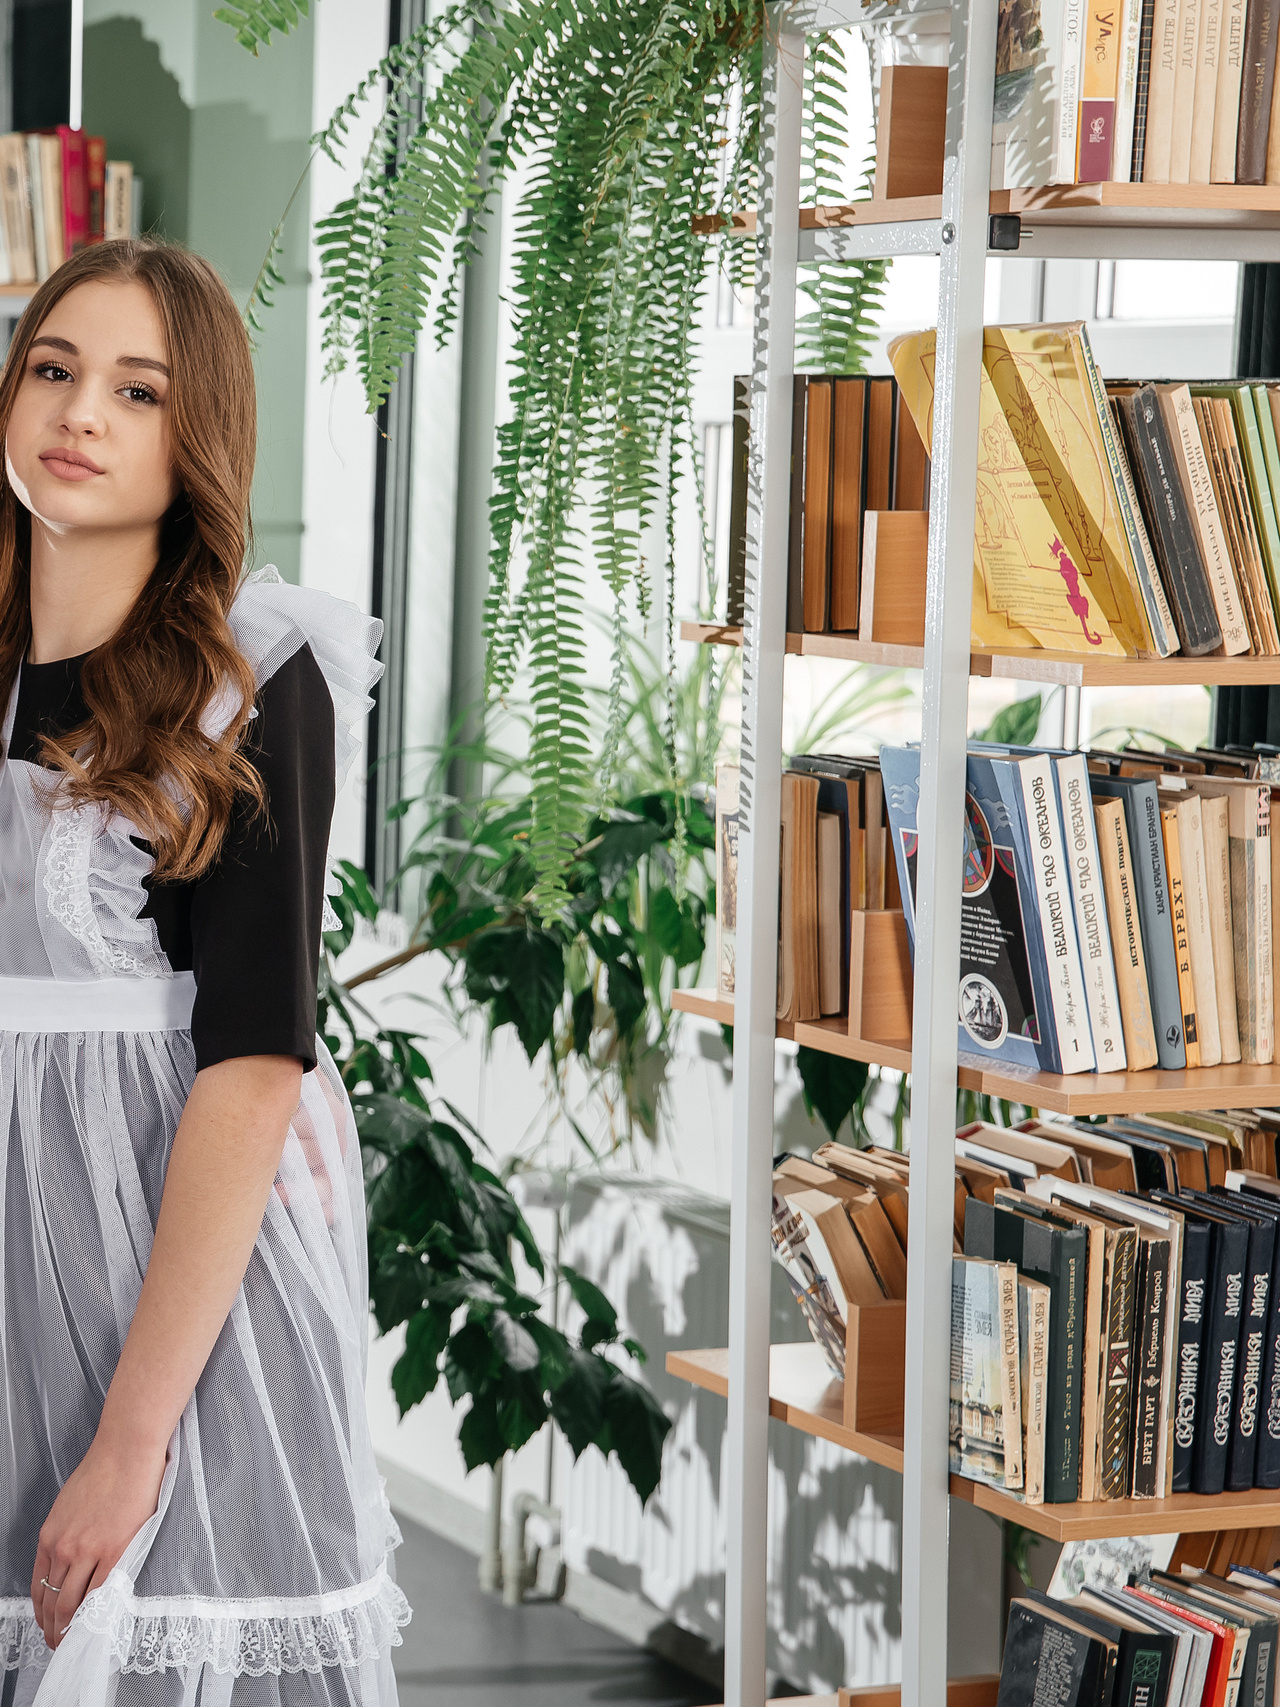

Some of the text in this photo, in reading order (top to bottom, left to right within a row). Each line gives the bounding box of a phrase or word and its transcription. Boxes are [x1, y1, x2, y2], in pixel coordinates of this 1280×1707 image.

[1162, 18, 1175, 70] ДАНТЕ
[1182, 17, 1195, 68] ДАНТЕ
[1205, 16, 1217, 67] ДАНТЕ
[1229, 16, 1241, 67] ДАНТЕ
[1104, 425, 1119, 477] Сказки
[1032, 776, 1068, 957] ВЕЛИКИЙ ЧАС ОКЕАНОВ
[1067, 778, 1103, 959] ВЕЛИКИЙ ЧАС ОКЕАНОВ
[1114, 816, 1125, 869] ПОВЕСТИ
[1145, 795, 1166, 914] ХАНС КРИСТИАН БРАННЕР
[1120, 873, 1138, 967] ИСТОРИЧЕСКИЕ
[1172, 877, 1189, 972] Б. БРЕХТ
[1071, 1038, 1079, 1052] 1
[1103, 1038, 1114, 1053] 2
[1121, 1240, 1129, 1280] ДЕТЕКТИВ
[1003, 1279, 1013, 1303] ЗМЕЯ
[1035, 1302, 1044, 1326] ЗМЕЯ
[1004, 1308, 1015, 1354] СТАЛЬНАЯ
[1033, 1330, 1043, 1376] СТАЛЬНАЯ
[1237, 1271, 1268, 1437] СКАЗОЧНИКИ МИРА
[1142, 1269, 1162, 1465] БРЕТ ГАРТ Гэбриель Конрой
[1173, 1277, 1204, 1448] СКАЗОЧНИКИ МИРА
[1212, 1271, 1241, 1445] СКАЗОЧНИКИ МИРА
